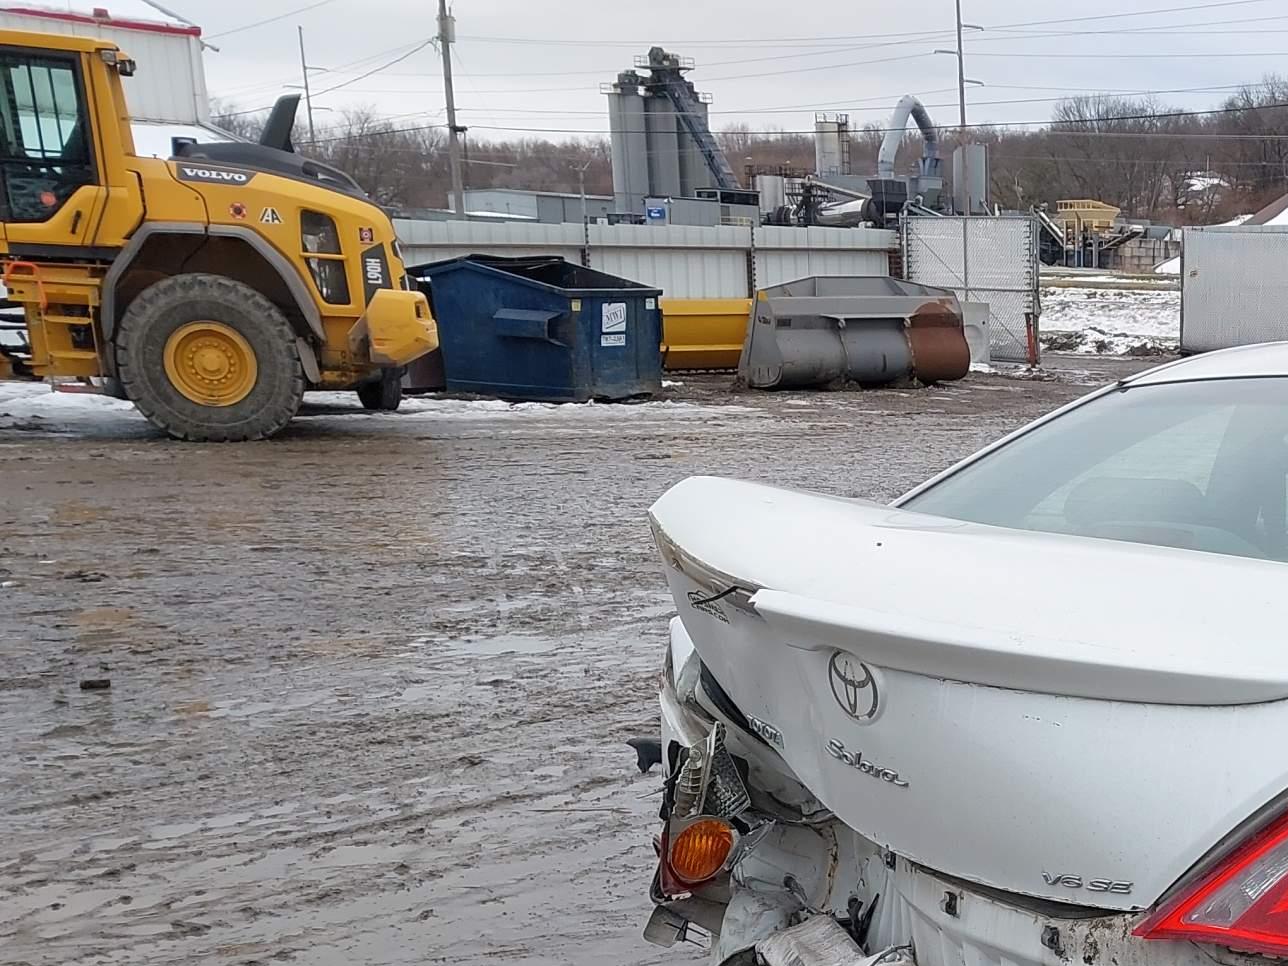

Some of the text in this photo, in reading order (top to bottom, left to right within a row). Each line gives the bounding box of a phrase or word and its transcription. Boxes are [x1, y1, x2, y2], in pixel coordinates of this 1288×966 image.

[181, 167, 247, 182] VOLVO
[365, 258, 383, 285] L90H
[824, 737, 909, 787] Solara
[1041, 871, 1134, 895] V6 SE
